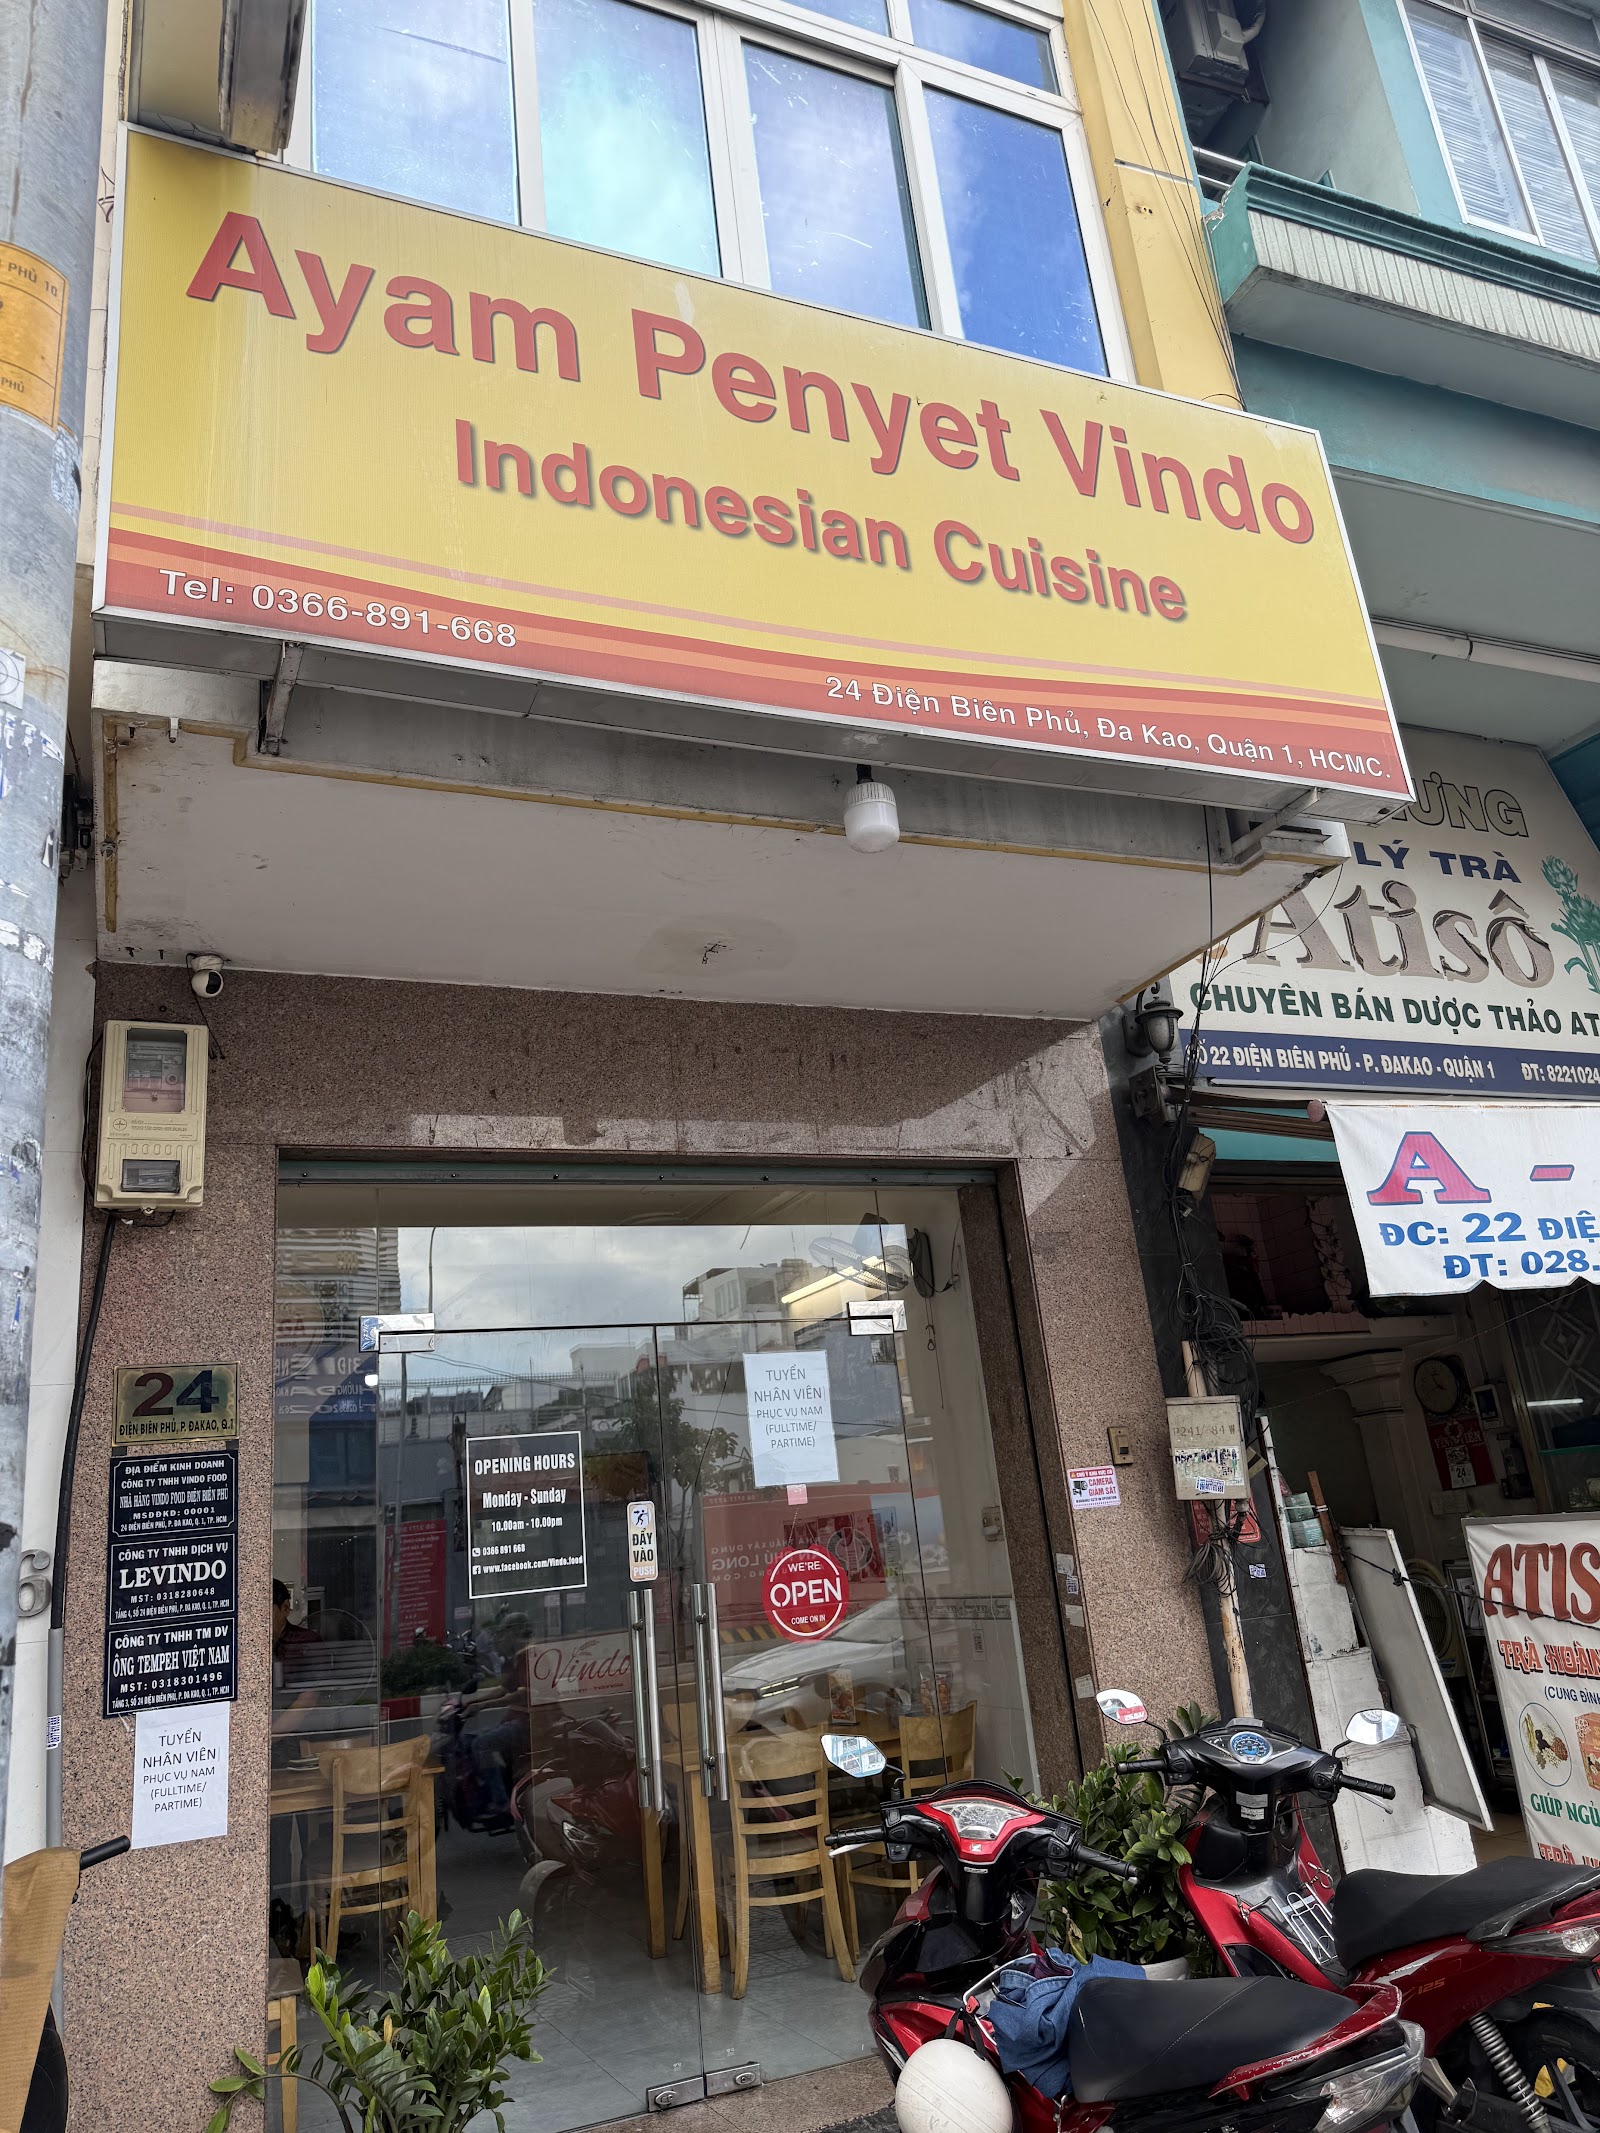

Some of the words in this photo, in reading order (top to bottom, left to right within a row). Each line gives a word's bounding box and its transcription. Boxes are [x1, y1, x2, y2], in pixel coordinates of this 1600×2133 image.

[8, 261, 37, 283] PHỦ
[1, 376, 25, 394] PHỦ
[186, 211, 580, 383] Ayam
[631, 308, 1021, 482] Penyet
[1039, 408, 1314, 545] Vindo
[455, 419, 908, 569] Indonesian
[934, 519, 1185, 620] Cuisine
[158, 567, 235, 605] Tel:
[251, 584, 518, 648] 0366-891-668
[826, 676, 861, 701] 24
[872, 682, 940, 715] Điện
[951, 695, 1016, 725] Biên
[1025, 706, 1089, 739] Phủ,
[1096, 717, 1133, 742] Đa
[1141, 723, 1200, 754] Kao,
[1207, 734, 1274, 763] Quận
[1282, 745, 1303, 768] 1,
[1309, 749, 1391, 778] HCMC.
[1393, 771, 1530, 837] ƯNG
[1353, 839, 1410, 869] LÝ
[1429, 851, 1522, 883] TRÀ
[1242, 880, 1555, 988] Atisô
[1189, 982, 1323, 1018] CHUYÊN
[1331, 987, 1395, 1022] BÁN
[1402, 995, 1481, 1034] DƯỢC
[1487, 998, 1562, 1034] THẢO
[1571, 1011, 1600, 1036] AT
[1211, 1046, 1231, 1065] 22
[1233, 1043, 1272, 1072] ĐIỆN
[1276, 1045, 1316, 1070] BIÊN
[1319, 1045, 1351, 1072] PHỦ
[1362, 1053, 1379, 1073] P.
[1381, 1054, 1433, 1076] ĐAKAO
[1443, 1055, 1485, 1084] QUẬN
[1487, 1061, 1495, 1079] 1
[1521, 1063, 1545, 1082] ĐT:
[1366, 1131, 1492, 1206] A
[1378, 1221, 1449, 1246] ĐC:
[1462, 1211, 1527, 1243] 22
[1443, 1253, 1508, 1279] ĐT:
[766, 1364, 806, 1381] TUYỂN
[132, 1370, 220, 1417] 24
[754, 1386, 790, 1402] NHÂN
[793, 1385, 822, 1400] VIÊN
[757, 1408, 783, 1419] PHỤC
[785, 1407, 798, 1417] VỤ
[800, 1406, 823, 1416] NAM
[120, 1421, 138, 1438] ĐIỆN
[141, 1420, 158, 1434] BIÊN
[160, 1418, 178, 1434] PHỦ,
[181, 1422, 186, 1432] P.
[188, 1419, 219, 1432] ĐAKAO,
[766, 1421, 817, 1435] (FULLTIME/
[771, 1436, 815, 1449] PARTIME)
[125, 1466, 141, 1476] ĐỊA
[143, 1460, 167, 1473] ĐIỂM
[170, 1462, 192, 1471] KINH
[194, 1460, 225, 1469] DOANH
[475, 1456, 531, 1475] OPENING
[534, 1453, 576, 1470] HOURS
[1456, 1467, 1466, 1478] 24
[121, 1478, 143, 1489] CÔNG
[145, 1479, 156, 1487] TY
[158, 1476, 179, 1486] TNHH
[181, 1475, 205, 1484] VINDO
[207, 1473, 227, 1482] FOOD
[1088, 1478, 1113, 1487] CAMERA
[482, 1490, 522, 1509] Monday
[530, 1487, 567, 1504] Sunday
[184, 1507, 215, 1515] 00001
[491, 1520, 524, 1532] 10.00am
[530, 1517, 563, 1529] 10.00pm
[632, 1528, 652, 1546] ĐẨY
[118, 1549, 145, 1561] CÔNG
[147, 1549, 159, 1558] TY
[162, 1546, 188, 1557] TNHH
[191, 1543, 213, 1556] DỊCH
[216, 1542, 229, 1553] VỤ
[633, 1547, 654, 1562] VÀO
[119, 1559, 226, 1589] LEVINDO
[633, 1565, 655, 1576] PUSH
[787, 1560, 821, 1573] WE'RE
[770, 1577, 842, 1608] OPEN
[1484, 1542, 1600, 1624] ATIS
[130, 1594, 153, 1603] MST:
[156, 1587, 215, 1601] 0318280648
[791, 1616, 808, 1625] COME
[809, 1615, 818, 1624] ON
[819, 1614, 825, 1622] IN
[114, 1634, 144, 1649] CÔNG
[147, 1633, 161, 1645] TY
[164, 1629, 192, 1643] TNHH
[195, 1627, 211, 1639] TM
[215, 1625, 229, 1637] DV
[113, 1653, 134, 1677] ÔNG
[137, 1651, 179, 1674] TEMPEH
[182, 1644, 206, 1671] VIỆT
[208, 1645, 230, 1666] NAM
[1497, 1636, 1543, 1674] TRÀ
[534, 1648, 631, 1688] Vindo
[120, 1682, 147, 1693] MST:
[151, 1672, 223, 1689] 0318301496
[1544, 1686, 1579, 1701] (CUNG
[158, 1727, 202, 1747] TUYỂN
[143, 1751, 182, 1768] NHÂN
[186, 1746, 216, 1763] VIÊN
[143, 1772, 171, 1785] PHỤC
[174, 1770, 188, 1781] VỤ
[191, 1766, 215, 1778] NAM
[150, 1781, 207, 1800] (FULLTIME/
[154, 1797, 202, 1813] PARTIME)
[1530, 1792, 1562, 1817] GIÚP
[1418, 1977, 1446, 1995] 125
